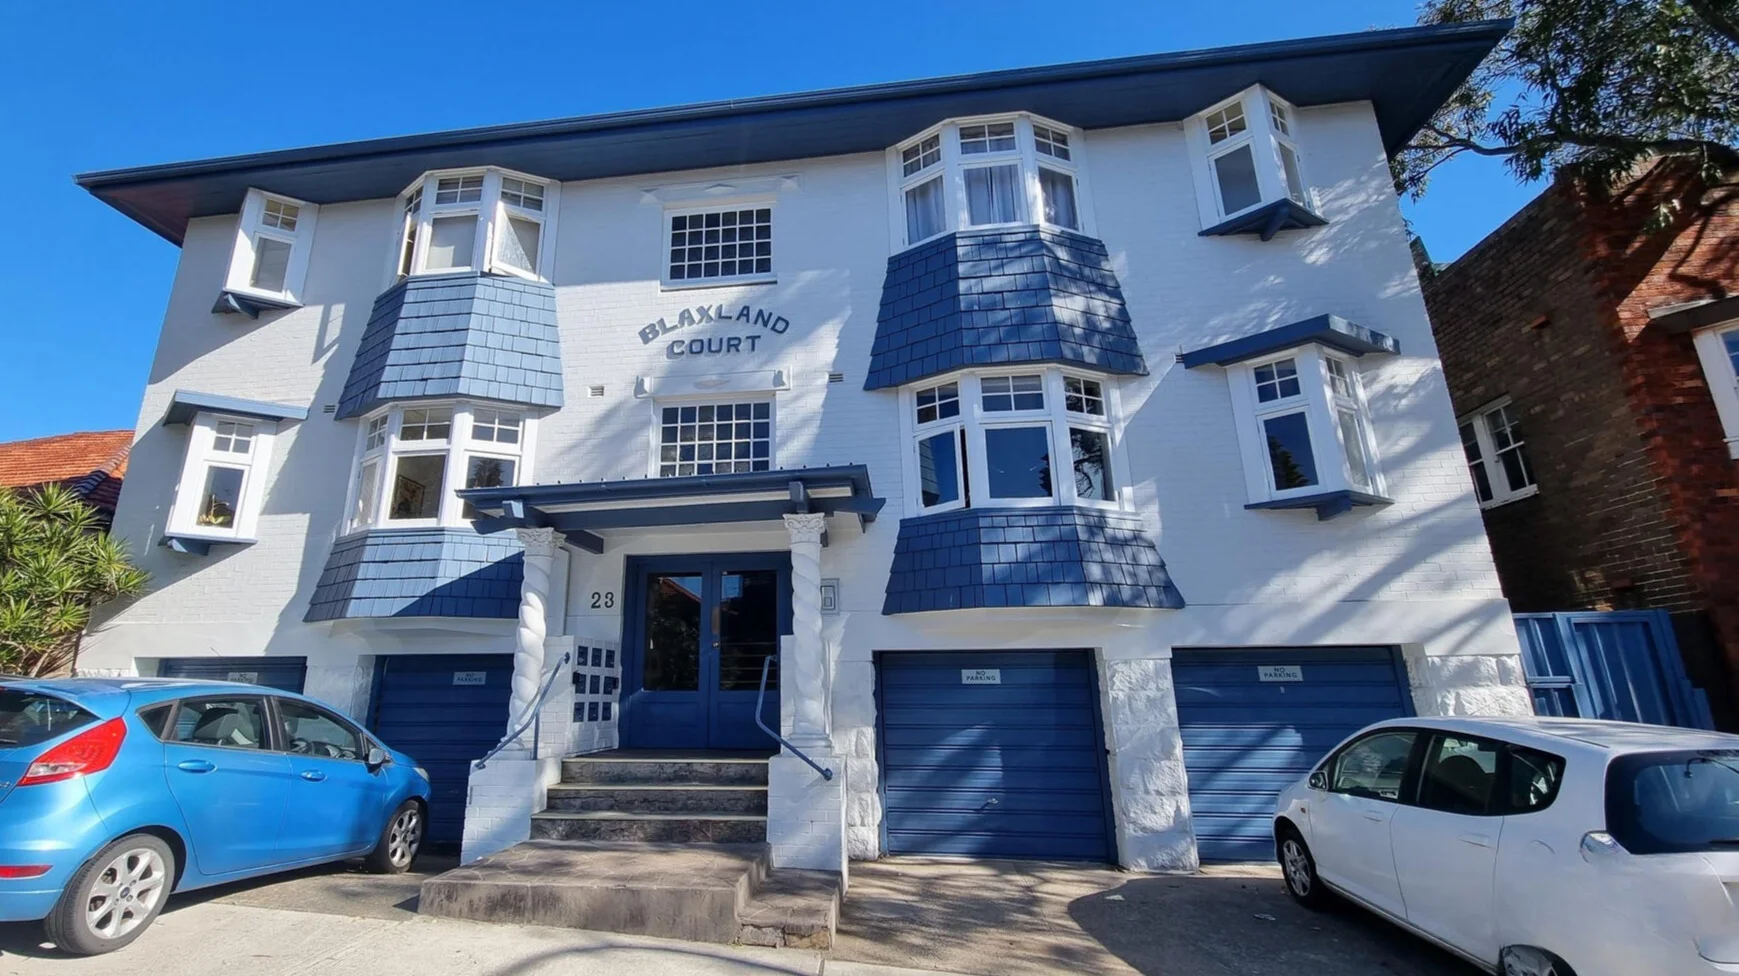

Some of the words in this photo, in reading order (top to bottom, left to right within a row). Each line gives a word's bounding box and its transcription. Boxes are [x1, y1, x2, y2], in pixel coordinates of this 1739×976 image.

[638, 304, 790, 345] BLAXLAND
[667, 335, 762, 358] COURT
[591, 591, 614, 609] 23
